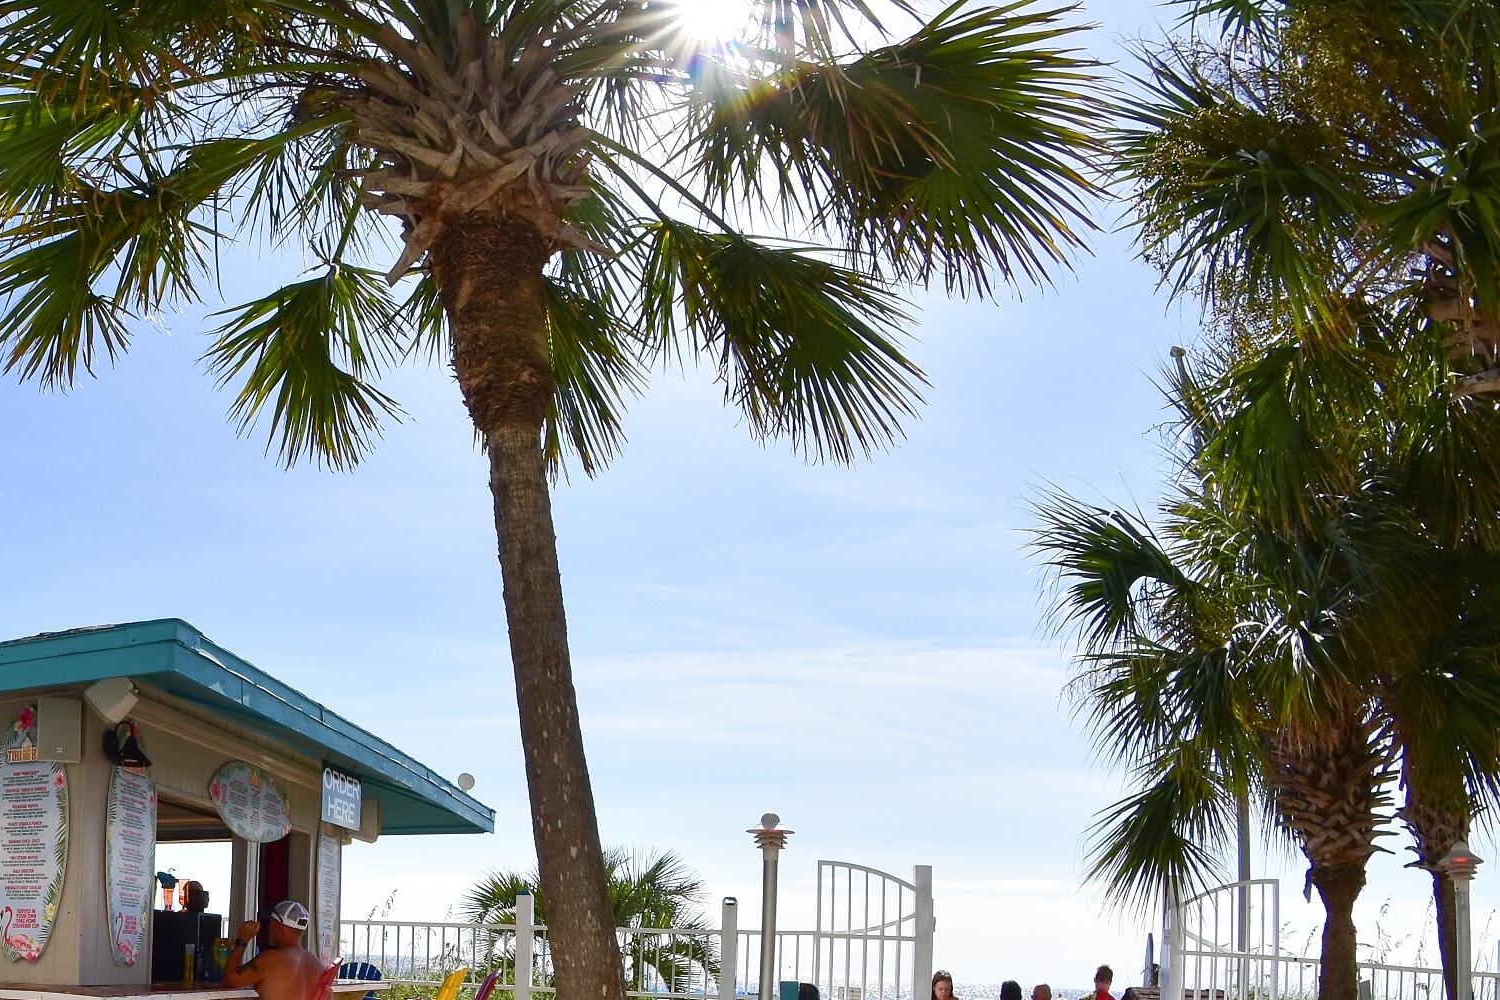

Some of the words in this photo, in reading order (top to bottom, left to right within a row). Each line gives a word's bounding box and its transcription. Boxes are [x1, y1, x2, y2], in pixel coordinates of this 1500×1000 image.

[8, 751, 22, 762] TIKI
[325, 768, 360, 801] ORDER
[328, 796, 355, 824] HERE
